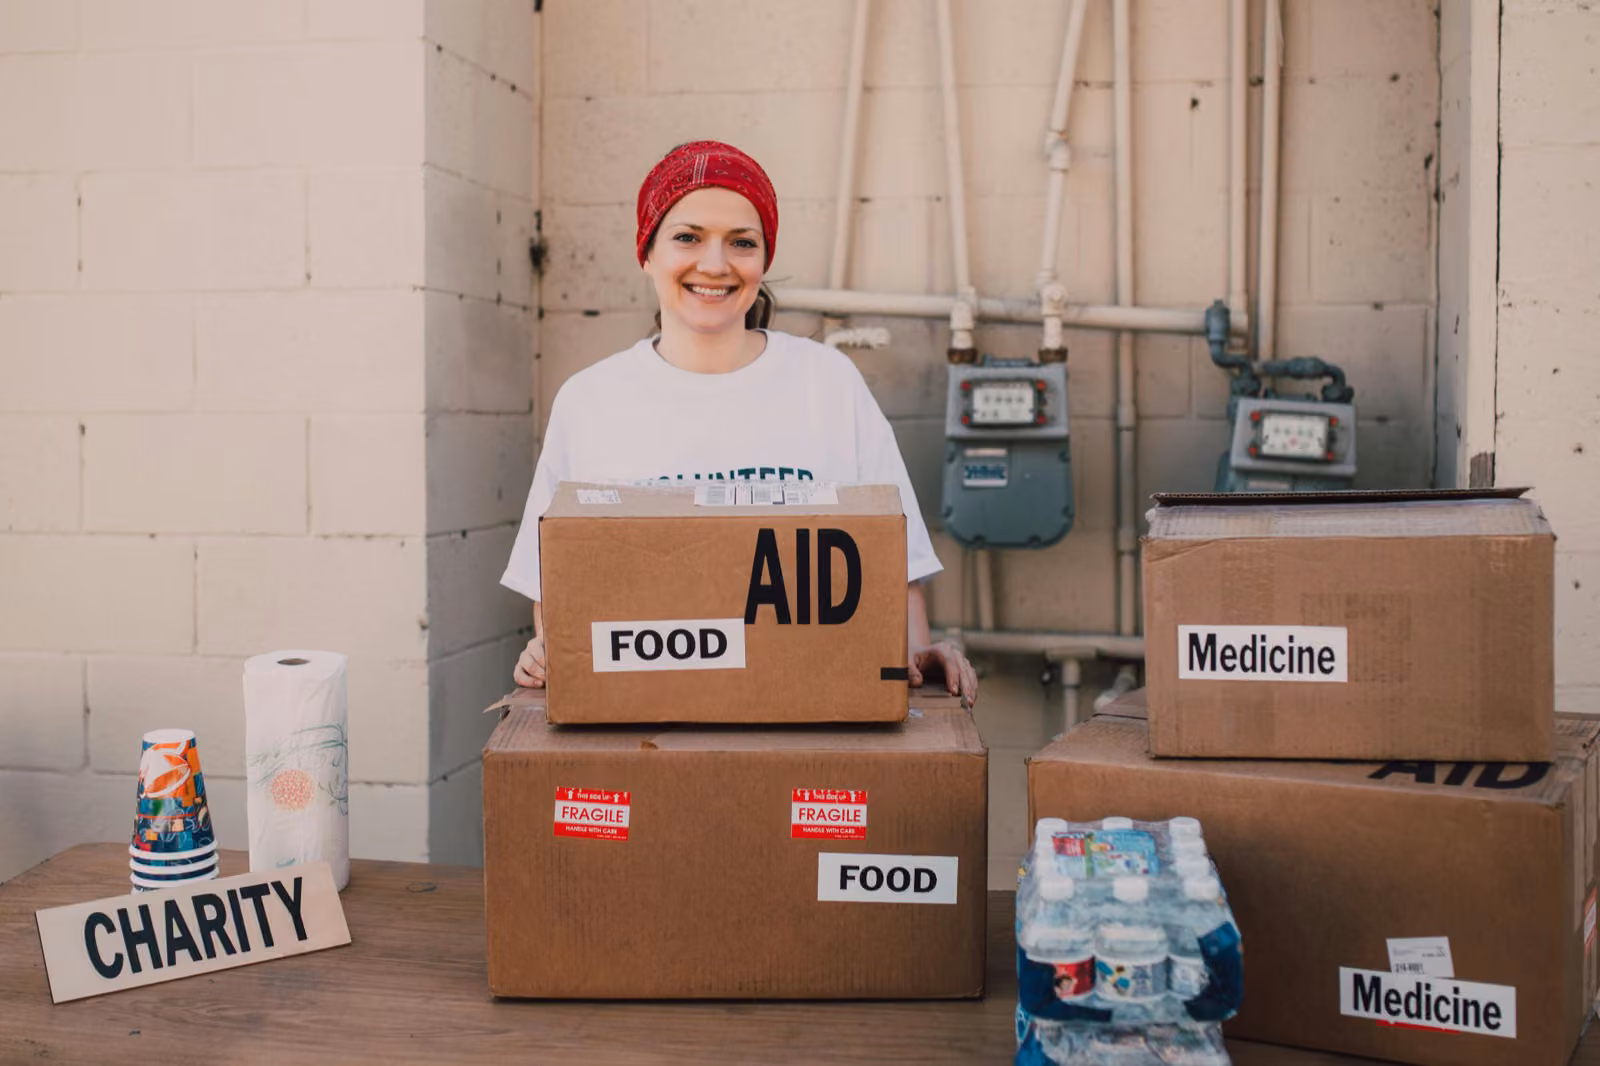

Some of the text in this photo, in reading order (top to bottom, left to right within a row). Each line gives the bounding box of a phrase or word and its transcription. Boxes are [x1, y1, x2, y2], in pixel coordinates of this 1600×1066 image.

[744, 528, 862, 625] AID
[610, 628, 728, 661] FOOD
[1188, 632, 1336, 675] Medicine
[561, 805, 624, 823] FRAGILE
[565, 825, 587, 833] HANDLE
[588, 826, 602, 834] WITH
[798, 807, 861, 823] FRAGILE
[839, 827, 856, 835] CARE
[839, 864, 938, 894] FOOD
[84, 876, 308, 979] CHARITY
[1352, 972, 1502, 1031] Medicine
